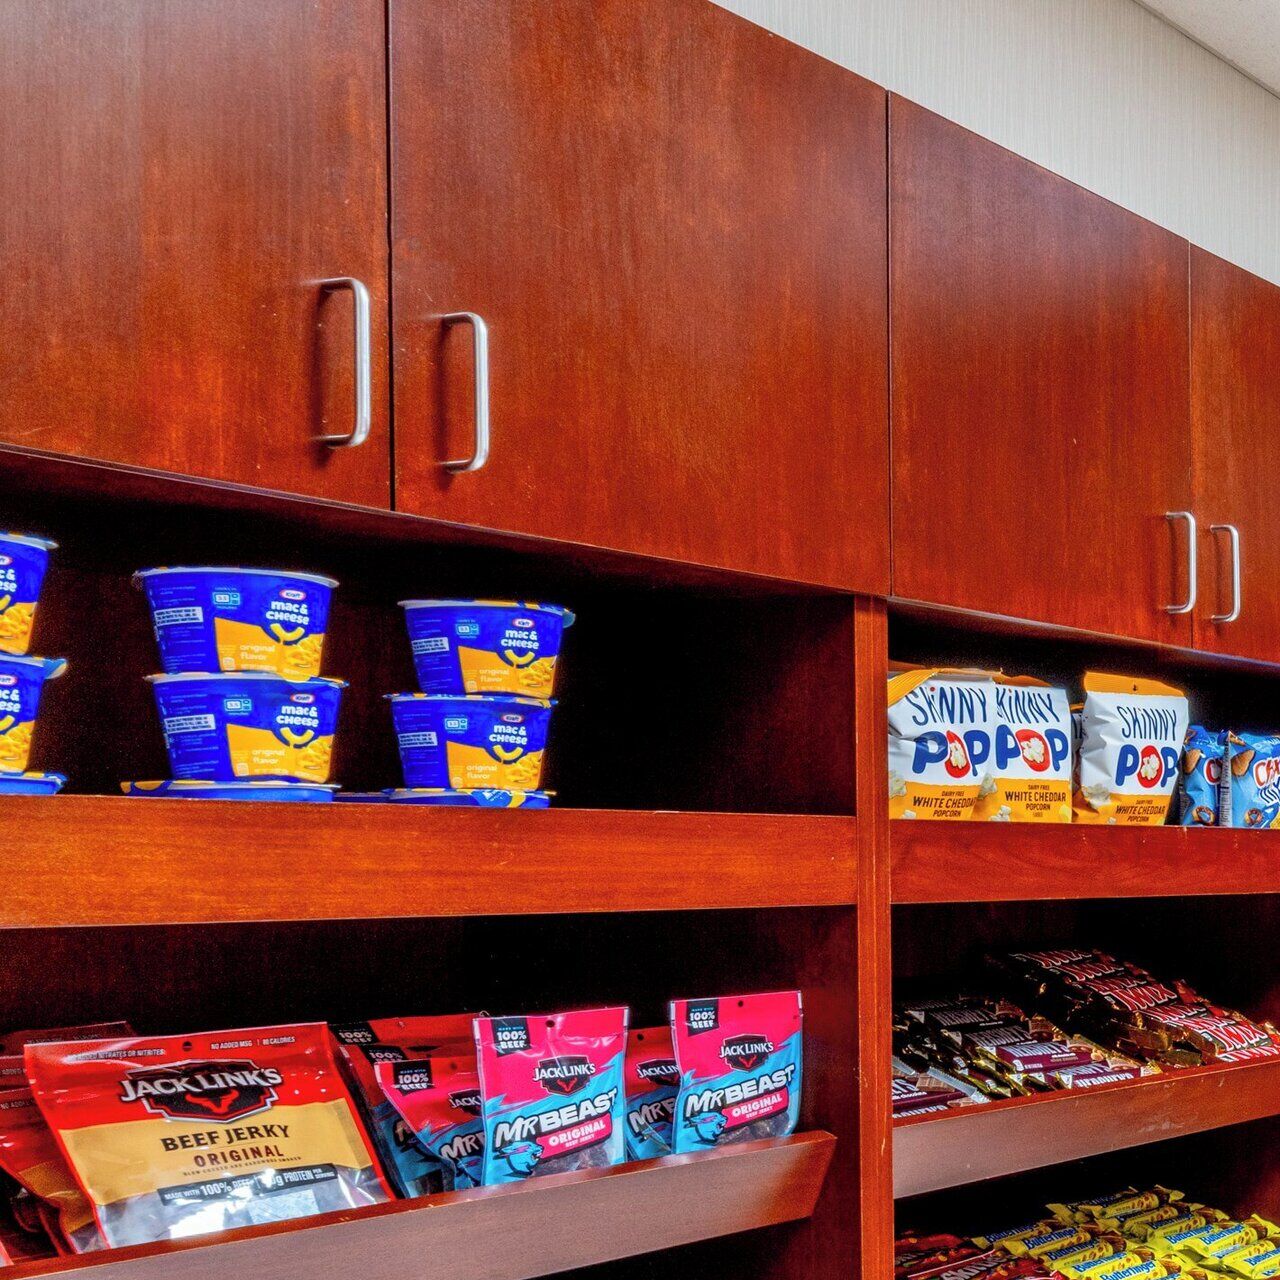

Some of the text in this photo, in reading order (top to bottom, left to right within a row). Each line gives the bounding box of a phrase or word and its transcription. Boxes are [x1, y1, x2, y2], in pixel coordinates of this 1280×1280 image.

[271, 602, 298, 612] mac
[505, 630, 528, 639] mac
[281, 706, 308, 716] mac
[493, 725, 517, 734] mac
[912, 730, 990, 778] POP
[996, 725, 1068, 771] POP
[1115, 745, 1178, 788] POP
[913, 797, 943, 808] WHITE
[1005, 792, 1066, 801] WHITE CHEDDAR
[1116, 805, 1164, 814] WHITE CHEDDAR
[1110, 985, 1177, 1010] TWIX
[690, 1012, 715, 1021] 100%
[692, 1020, 714, 1028] BEEF
[270, 1037, 295, 1045] CALORIES
[497, 1031, 526, 1040] 100%
[1207, 1025, 1268, 1051] TWIX
[221, 1041, 238, 1049] ADDED
[500, 1041, 525, 1049] BEEF
[720, 1042, 774, 1058] JACK LINK'S
[399, 1073, 429, 1083] 100%
[534, 1064, 596, 1080] JACK LINK'S
[120, 1068, 283, 1101] JACK LINK'S
[732, 1094, 783, 1117] ORIGINAL
[160, 1124, 290, 1151] BEEF JERKY
[549, 1120, 605, 1145] ORIGINAL
[194, 1145, 284, 1167] ORIGINAL
[284, 1171, 312, 1184] PROTEIN
[200, 1183, 232, 1196] 100%
